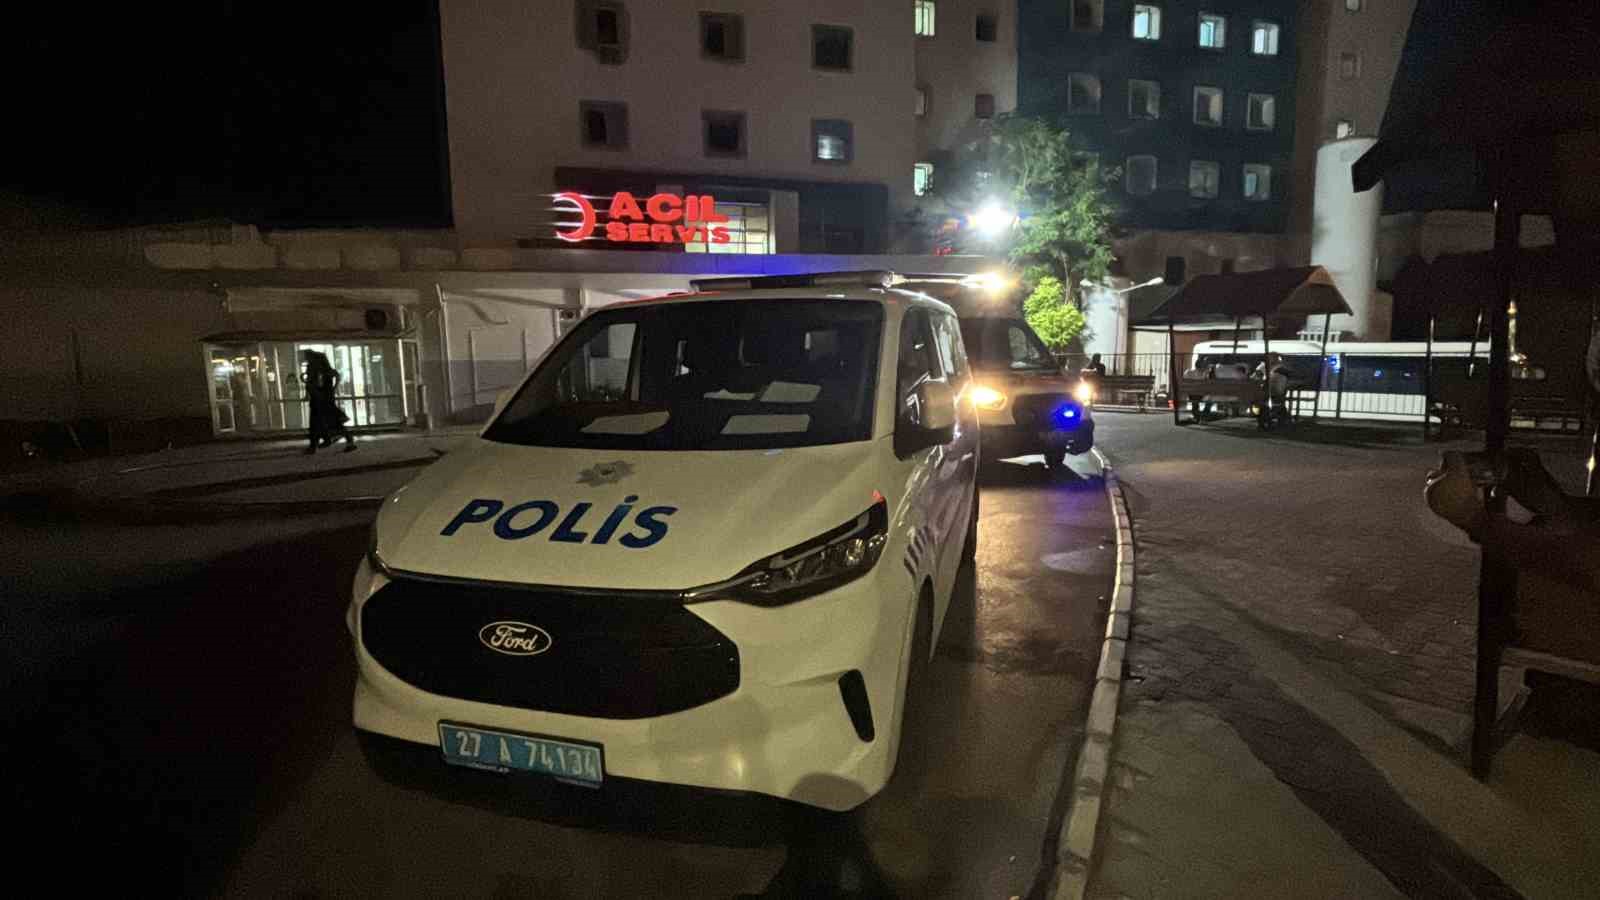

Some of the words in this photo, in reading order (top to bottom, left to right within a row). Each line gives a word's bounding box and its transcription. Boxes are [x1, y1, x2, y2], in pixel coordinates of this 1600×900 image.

[608, 191, 729, 223] ACIL
[439, 494, 678, 549] POLİS
[490, 624, 539, 651] Ford
[455, 731, 481, 757] 27
[499, 737, 513, 764] A
[524, 740, 598, 778] 74134
